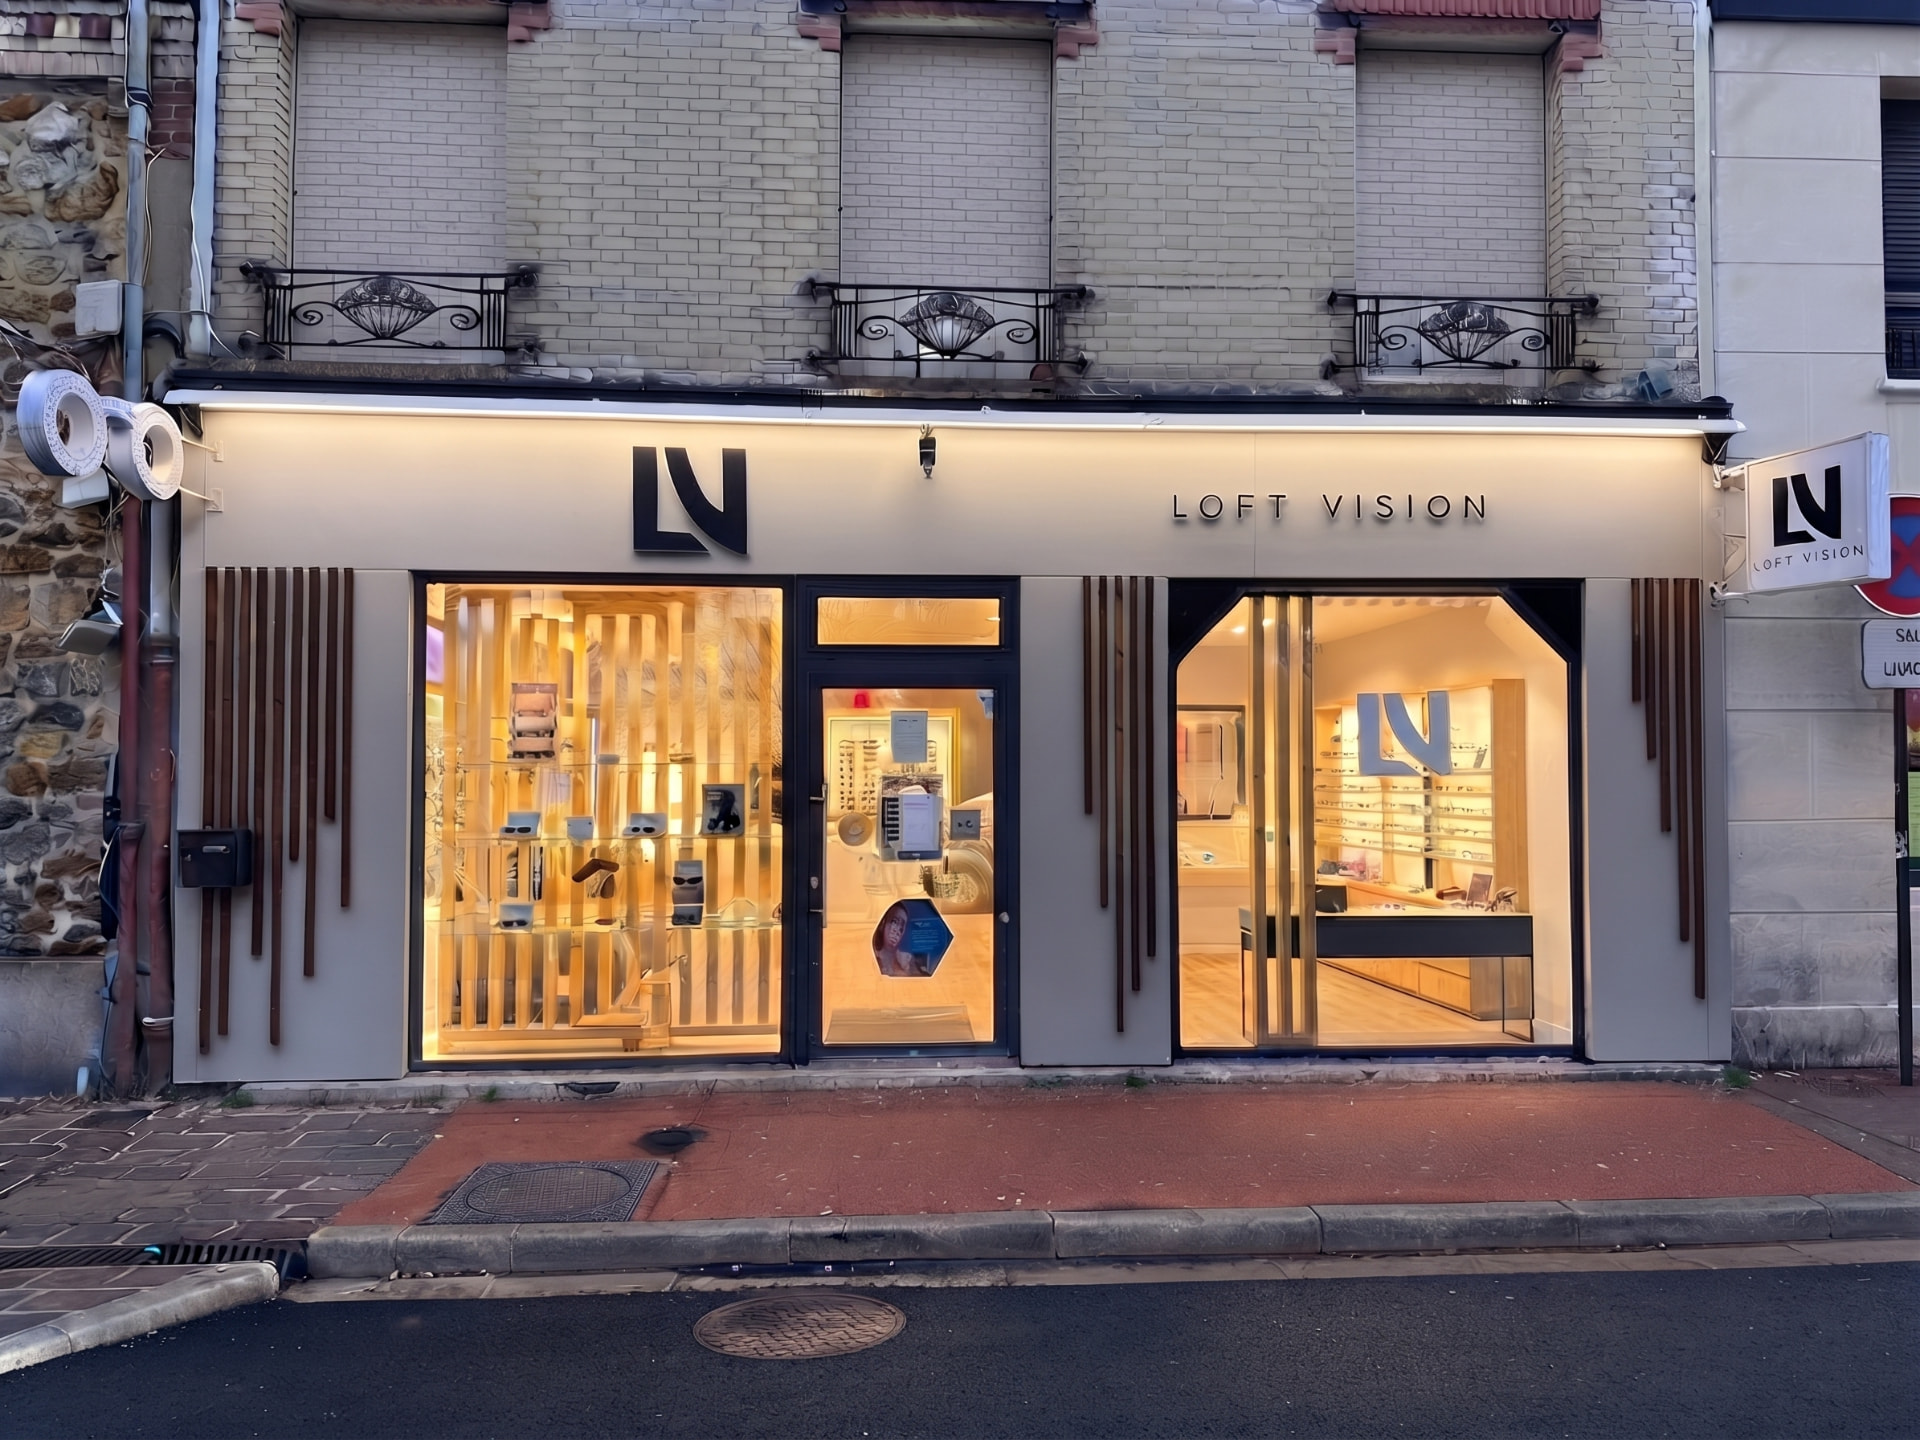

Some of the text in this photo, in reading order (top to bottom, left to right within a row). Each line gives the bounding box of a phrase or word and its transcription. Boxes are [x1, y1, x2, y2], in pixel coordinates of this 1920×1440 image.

[1173, 494, 1486, 518] LOFT VISION
[1803, 544, 1864, 563] VISION
